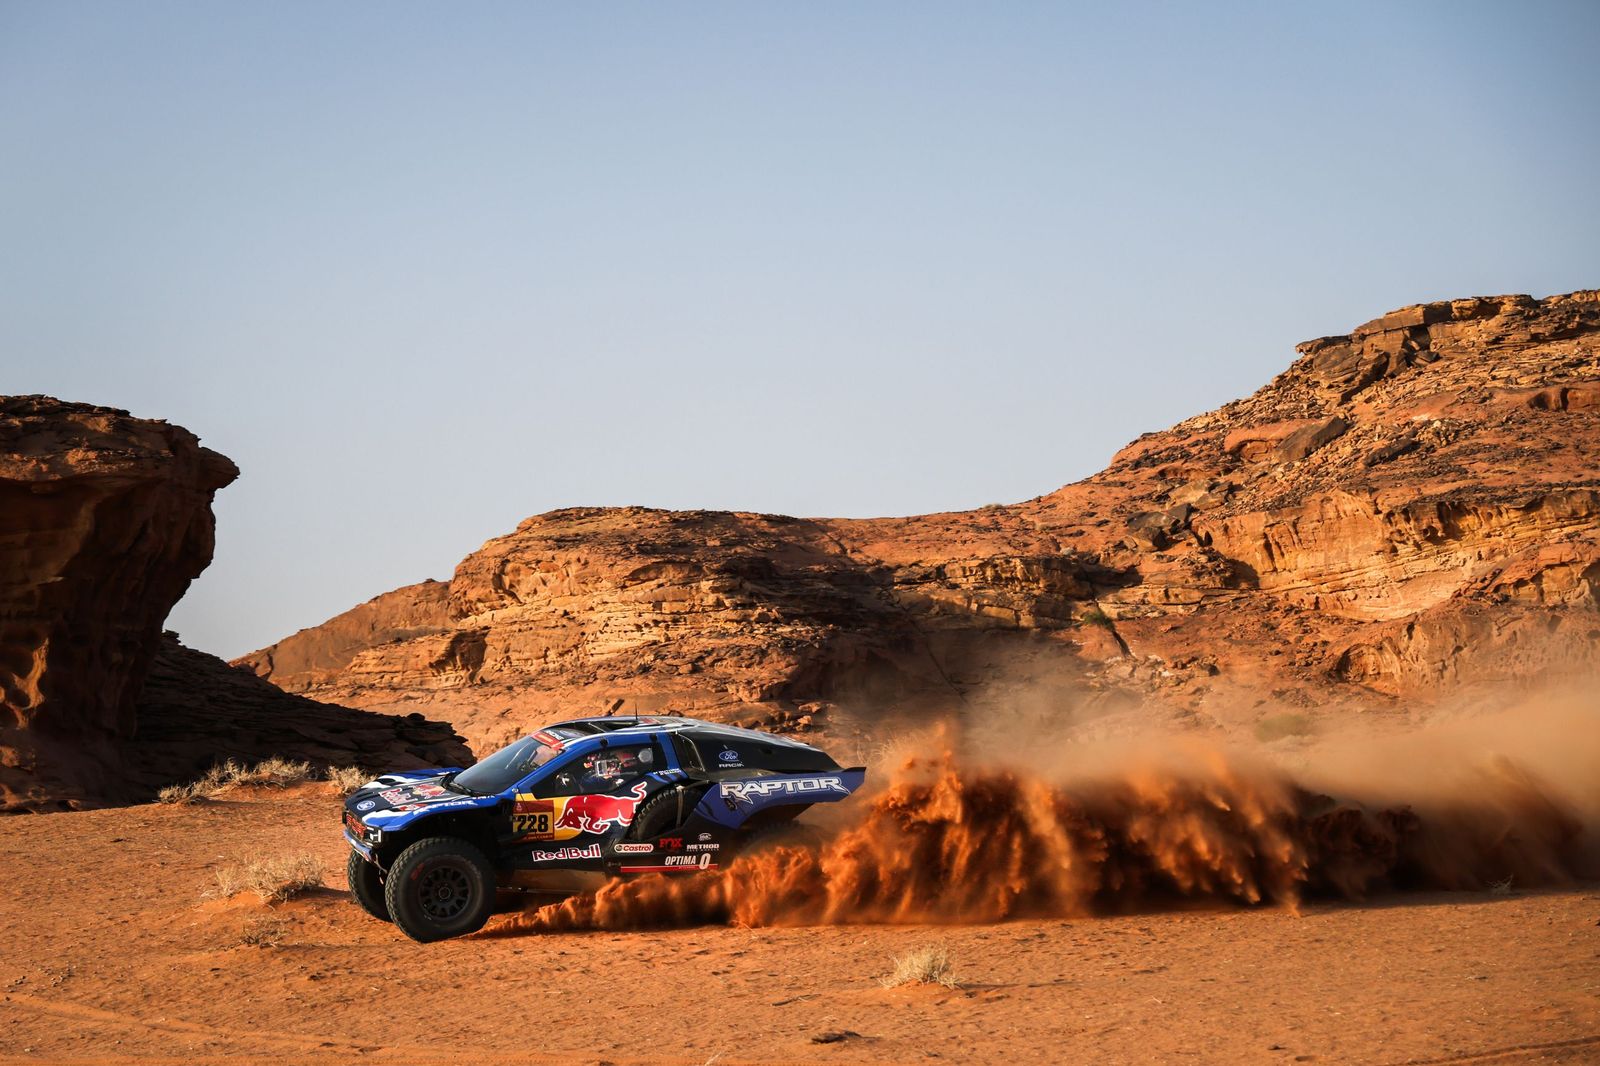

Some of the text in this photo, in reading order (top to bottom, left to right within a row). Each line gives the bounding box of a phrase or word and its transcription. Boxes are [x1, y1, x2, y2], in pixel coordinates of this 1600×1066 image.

[719, 776, 851, 804] RAPTOR
[516, 814, 549, 832] 228
[532, 843, 601, 862] Red Bull
[623, 844, 652, 852] Castrol
[664, 856, 697, 866] OPTIMA
